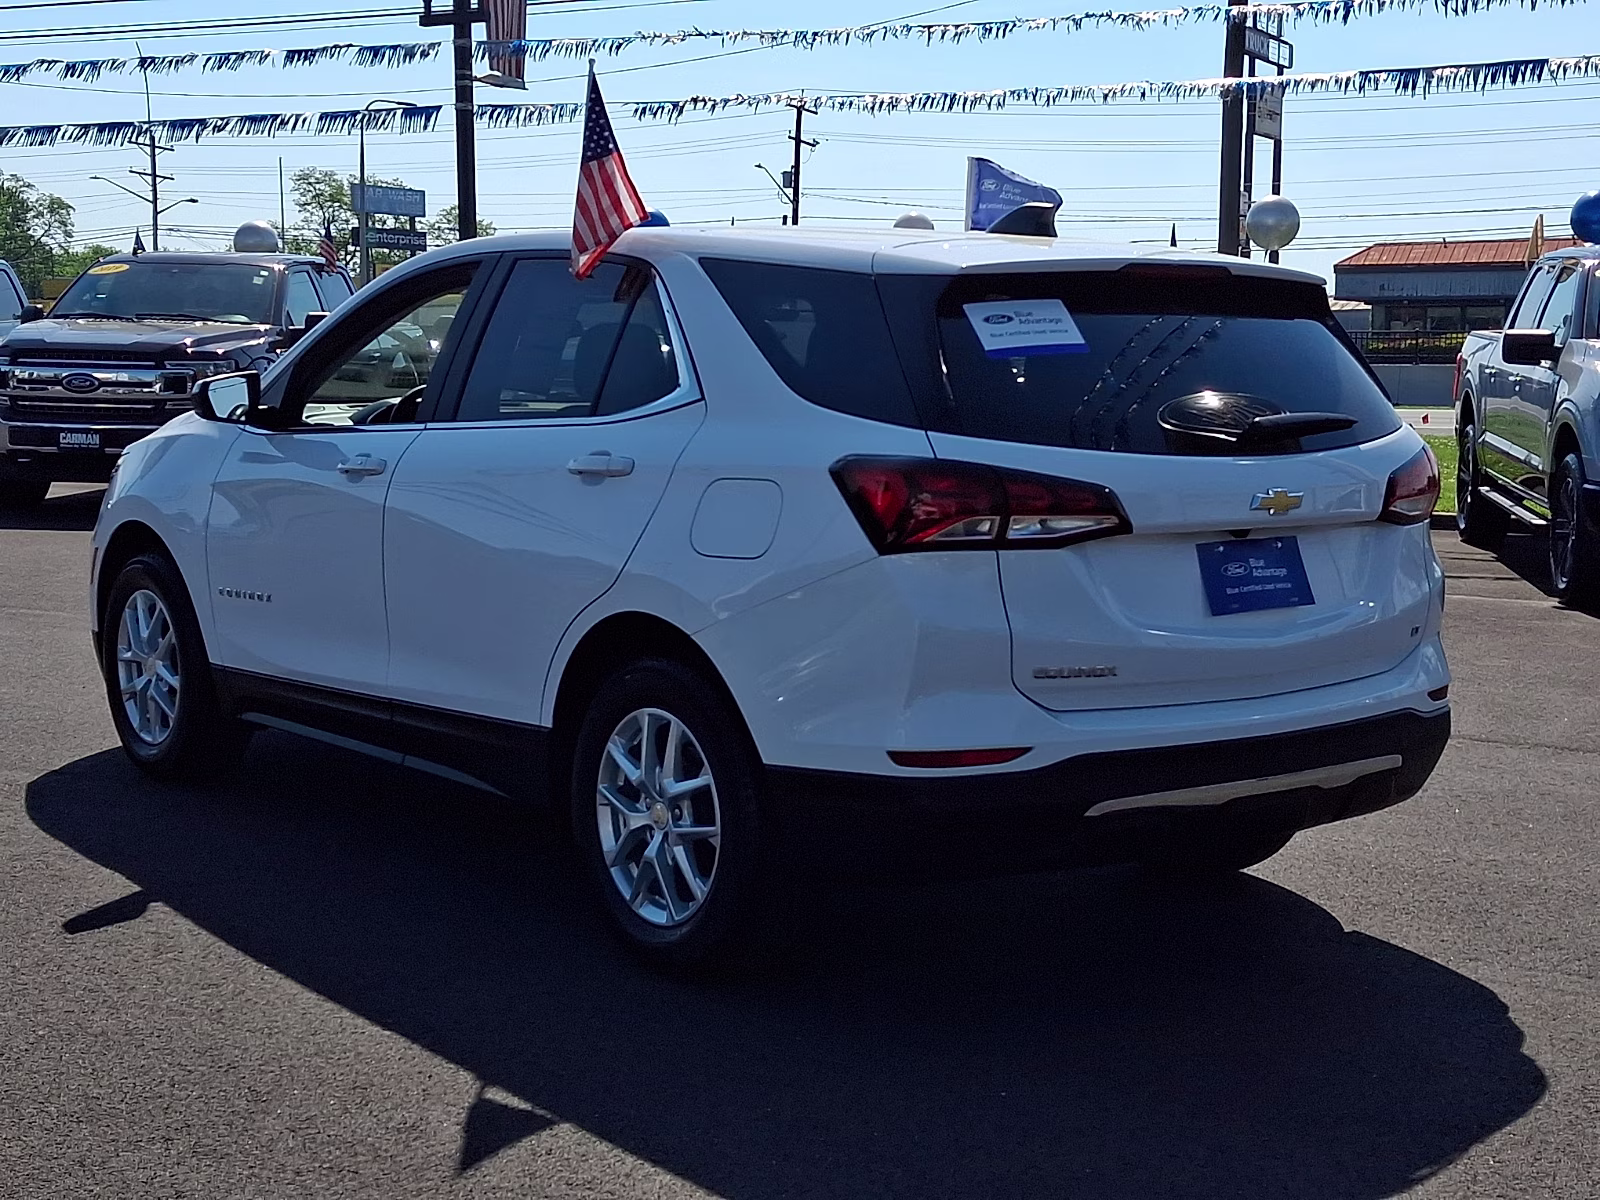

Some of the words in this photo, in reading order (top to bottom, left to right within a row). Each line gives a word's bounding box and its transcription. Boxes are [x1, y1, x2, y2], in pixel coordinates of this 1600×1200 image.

[364, 188, 383, 199] AR
[388, 190, 421, 203] WASH
[366, 231, 426, 246] enterprise
[1018, 317, 1063, 325] Advantage
[59, 432, 100, 445] CARMAN
[1249, 558, 1266, 568] Blue
[1252, 567, 1288, 577] Advantage
[218, 587, 273, 603] EQUINOX
[1032, 665, 1118, 679] EQUINOX
